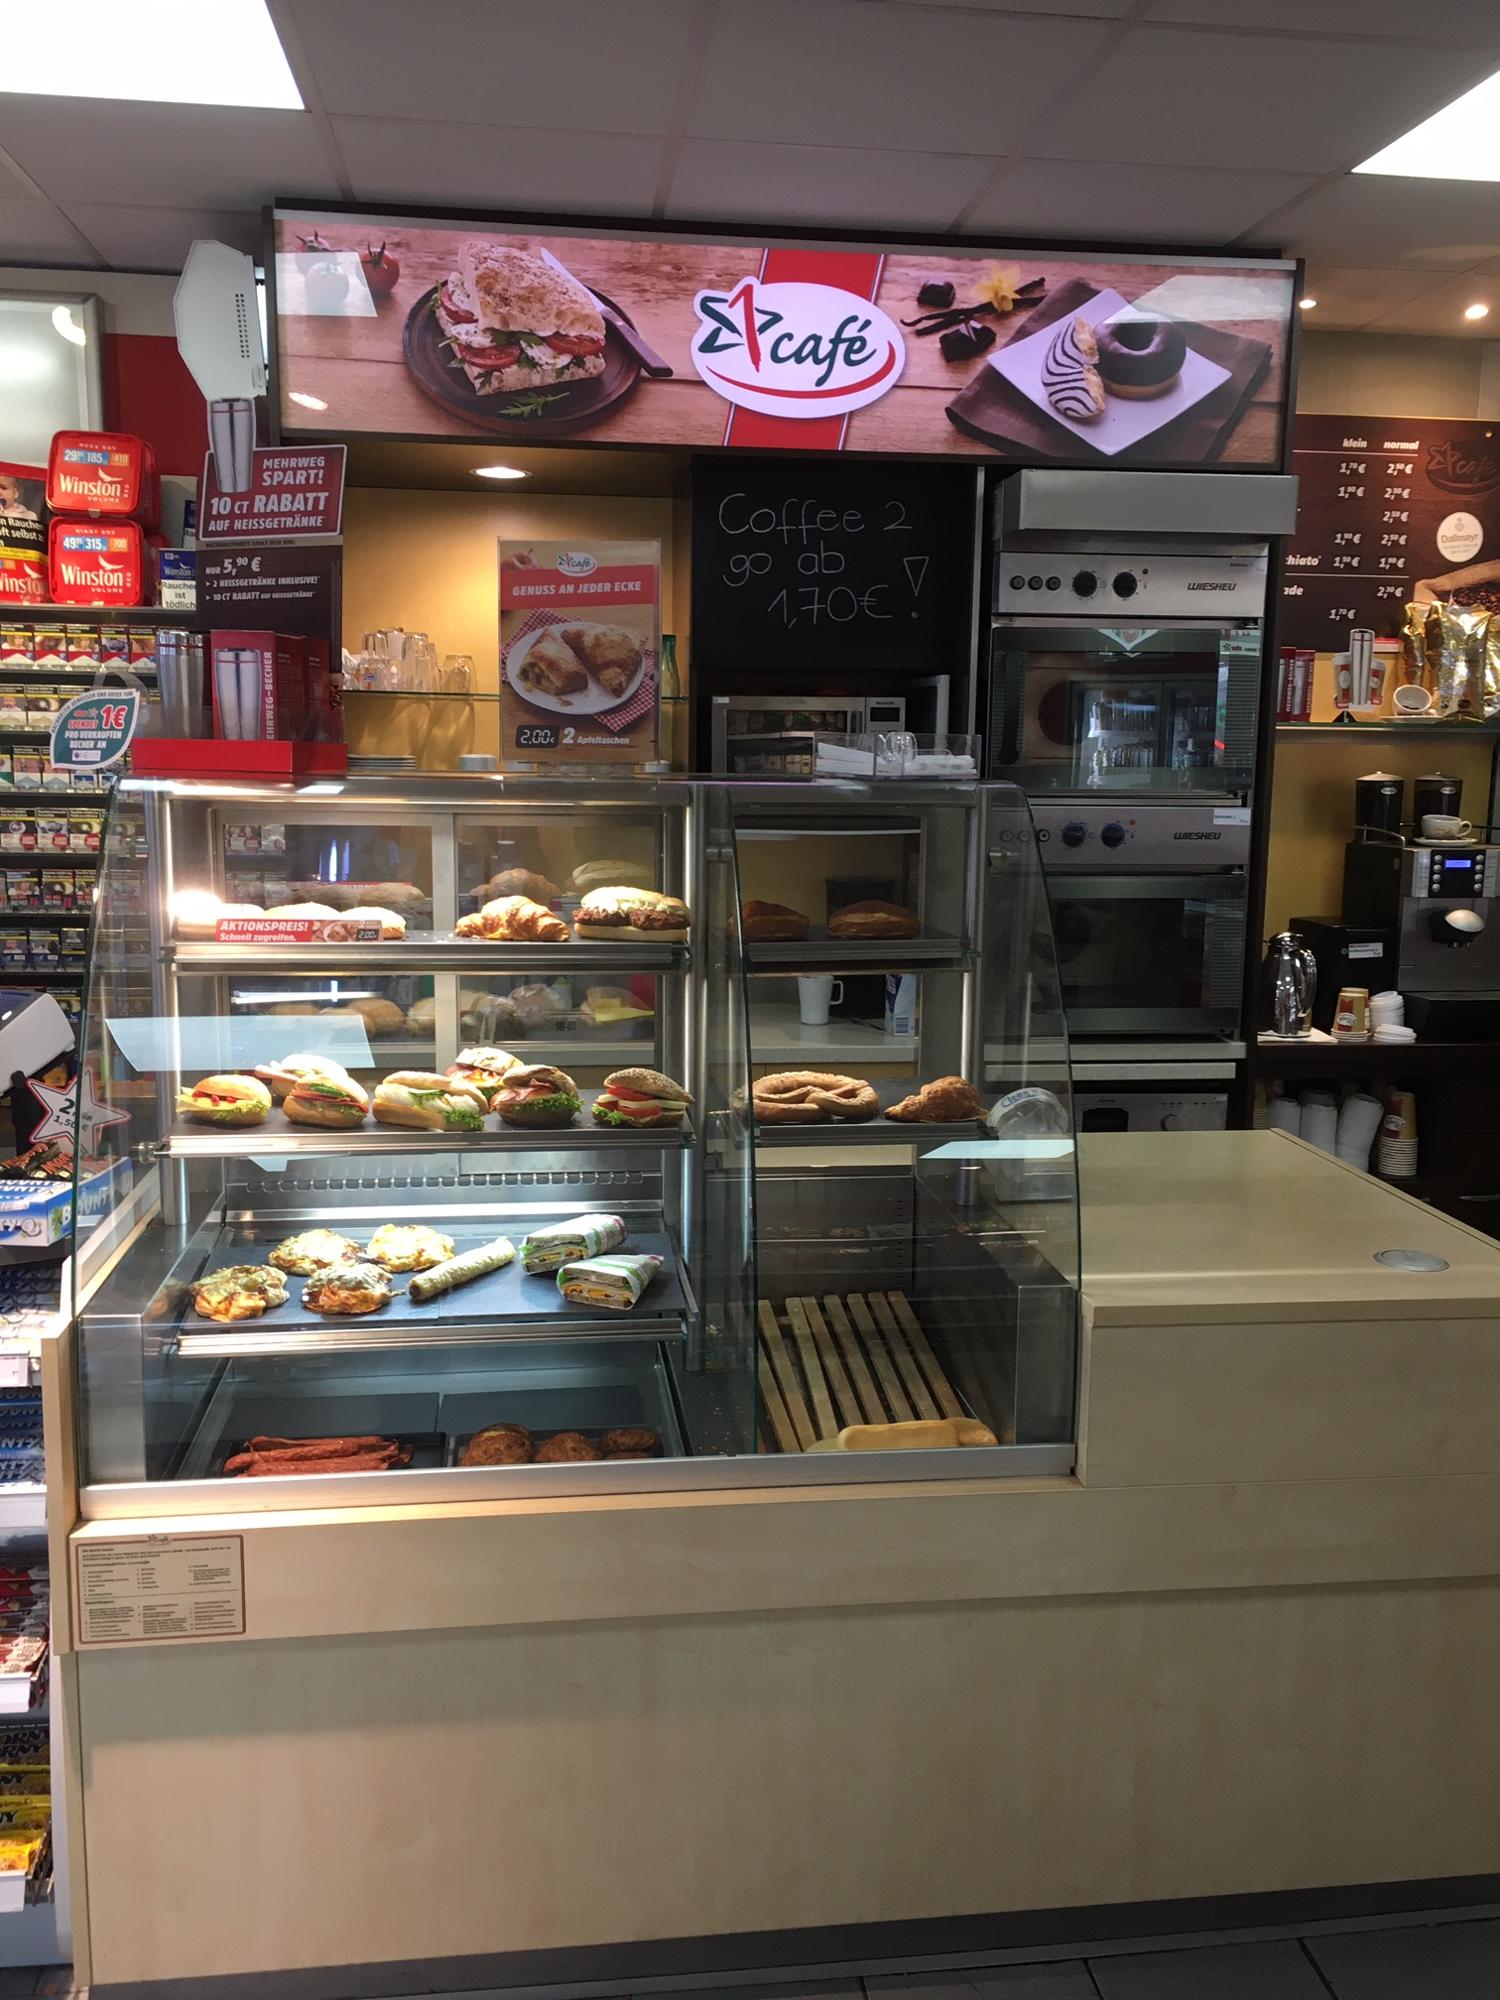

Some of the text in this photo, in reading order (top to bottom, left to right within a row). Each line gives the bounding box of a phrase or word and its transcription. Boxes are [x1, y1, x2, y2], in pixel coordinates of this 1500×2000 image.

[1342, 438, 1420, 450] klein normal
[263, 456, 326, 469] MEHRWEG
[262, 470, 324, 486] SPART!
[60, 473, 121, 497] Winston
[210, 492, 330, 515] 10 CT RABATT
[718, 493, 913, 545] Coffee 2
[208, 520, 231, 532] AUF
[12, 529, 37, 540] selbst
[1441, 534, 1479, 544] Dallmayr
[722, 540, 845, 588] go ab
[1286, 554, 1319, 566] hiato
[61, 563, 123, 587] Winston
[205, 567, 220, 575] NUR
[0, 573, 44, 596] insto
[278, 575, 318, 585] INKLUSIVE!
[512, 581, 642, 597] GENUSS AN JEDER ECKE
[1187, 582, 1237, 591] WIESHEU
[175, 592, 187, 600] ist
[232, 591, 260, 600] RABATT
[768, 584, 893, 629] 1,70€
[264, 652, 275, 740] EHRWEG-BECHER
[102, 705, 127, 729] 1€
[80, 731, 122, 739] VERKAUFTEN
[562, 727, 575, 744] 2
[576, 735, 630, 746] Apfeltaschen
[69, 740, 106, 749] BECHER AN
[1173, 831, 1221, 841] WIESHEU
[220, 921, 309, 932] AKTIONSPREIS!
[220, 932, 297, 942] Schnell zugreifen.
[59, 1098, 75, 1115] 2
